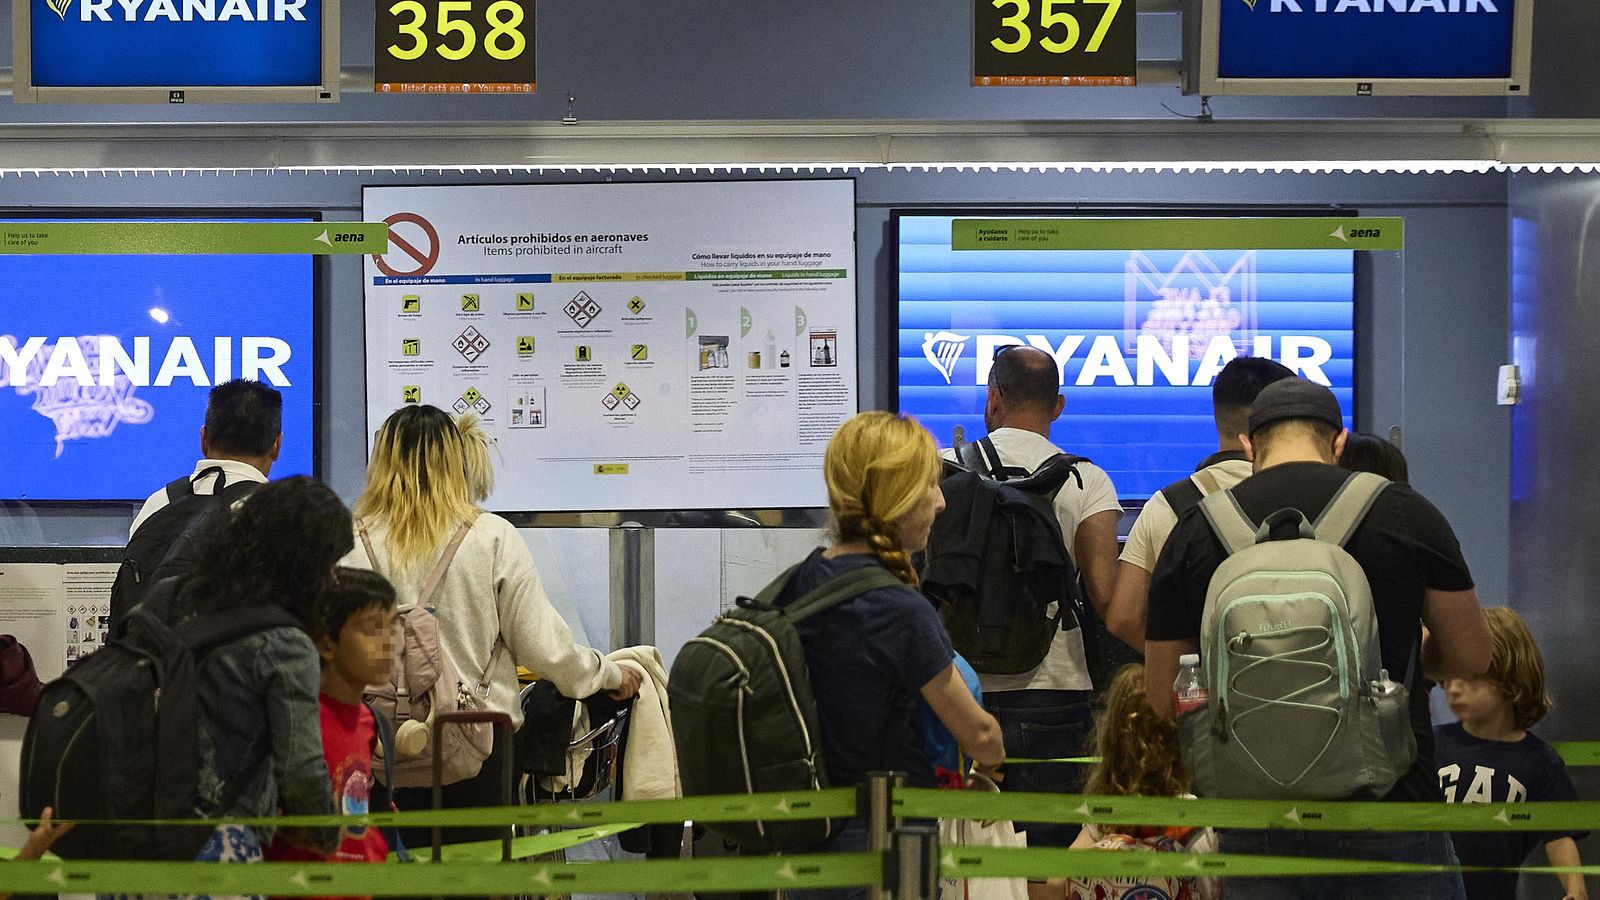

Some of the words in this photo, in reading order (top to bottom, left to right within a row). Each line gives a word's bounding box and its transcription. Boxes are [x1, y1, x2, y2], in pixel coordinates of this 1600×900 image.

[80, 0, 307, 21] RYANAIR
[388, 0, 526, 61] 358
[990, 0, 1122, 54] 357
[401, 84, 425, 92] Usted
[428, 84, 447, 92] está
[478, 84, 494, 92] You
[513, 84, 522, 92] in
[335, 233, 364, 242] aena
[1350, 229, 1380, 238] aena
[457, 234, 508, 245] Artículos
[511, 233, 572, 246] prohibidos
[574, 234, 588, 243] en
[590, 233, 649, 243] aeronaves
[484, 246, 513, 256] Items
[515, 245, 571, 257] prohibited
[573, 245, 584, 255] in
[586, 244, 623, 254] aircraft
[692, 252, 711, 260] Cómo
[731, 252, 756, 260] líquidos
[775, 252, 802, 260] equipaje
[798, 260, 823, 268] luggage
[689, 317, 694, 327] 1
[743, 316, 751, 327] 2
[797, 316, 805, 326] 3
